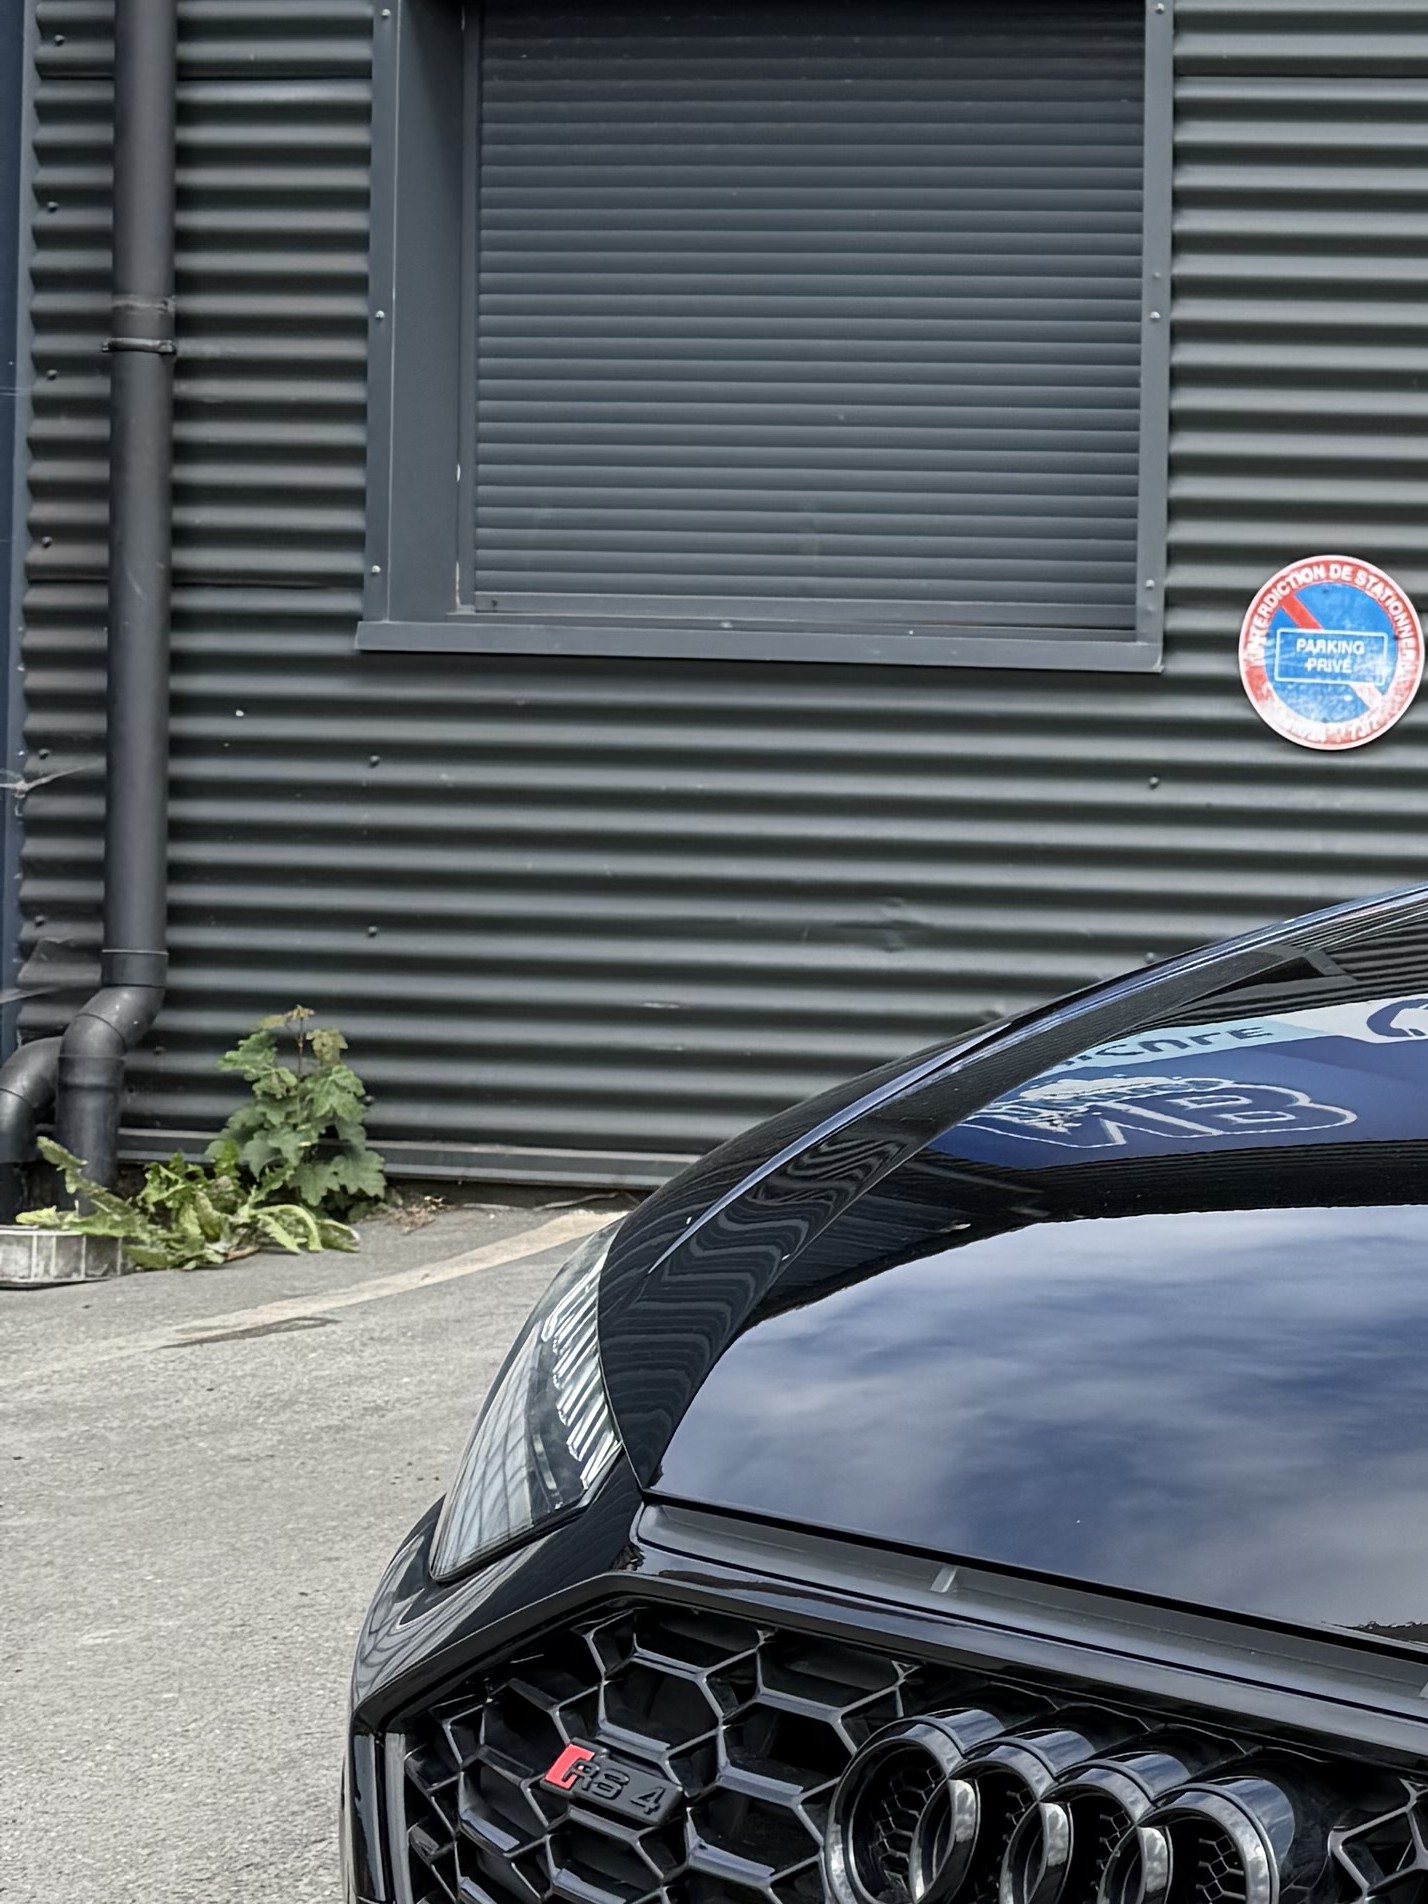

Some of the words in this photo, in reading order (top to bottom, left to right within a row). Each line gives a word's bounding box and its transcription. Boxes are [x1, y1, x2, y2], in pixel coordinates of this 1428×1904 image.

[1328, 562, 1353, 581] DE
[1296, 637, 1366, 656] PARKING
[1304, 656, 1353, 674] PRIVÉ
[560, 1759, 632, 1801] RS
[630, 1786, 667, 1816] 4
